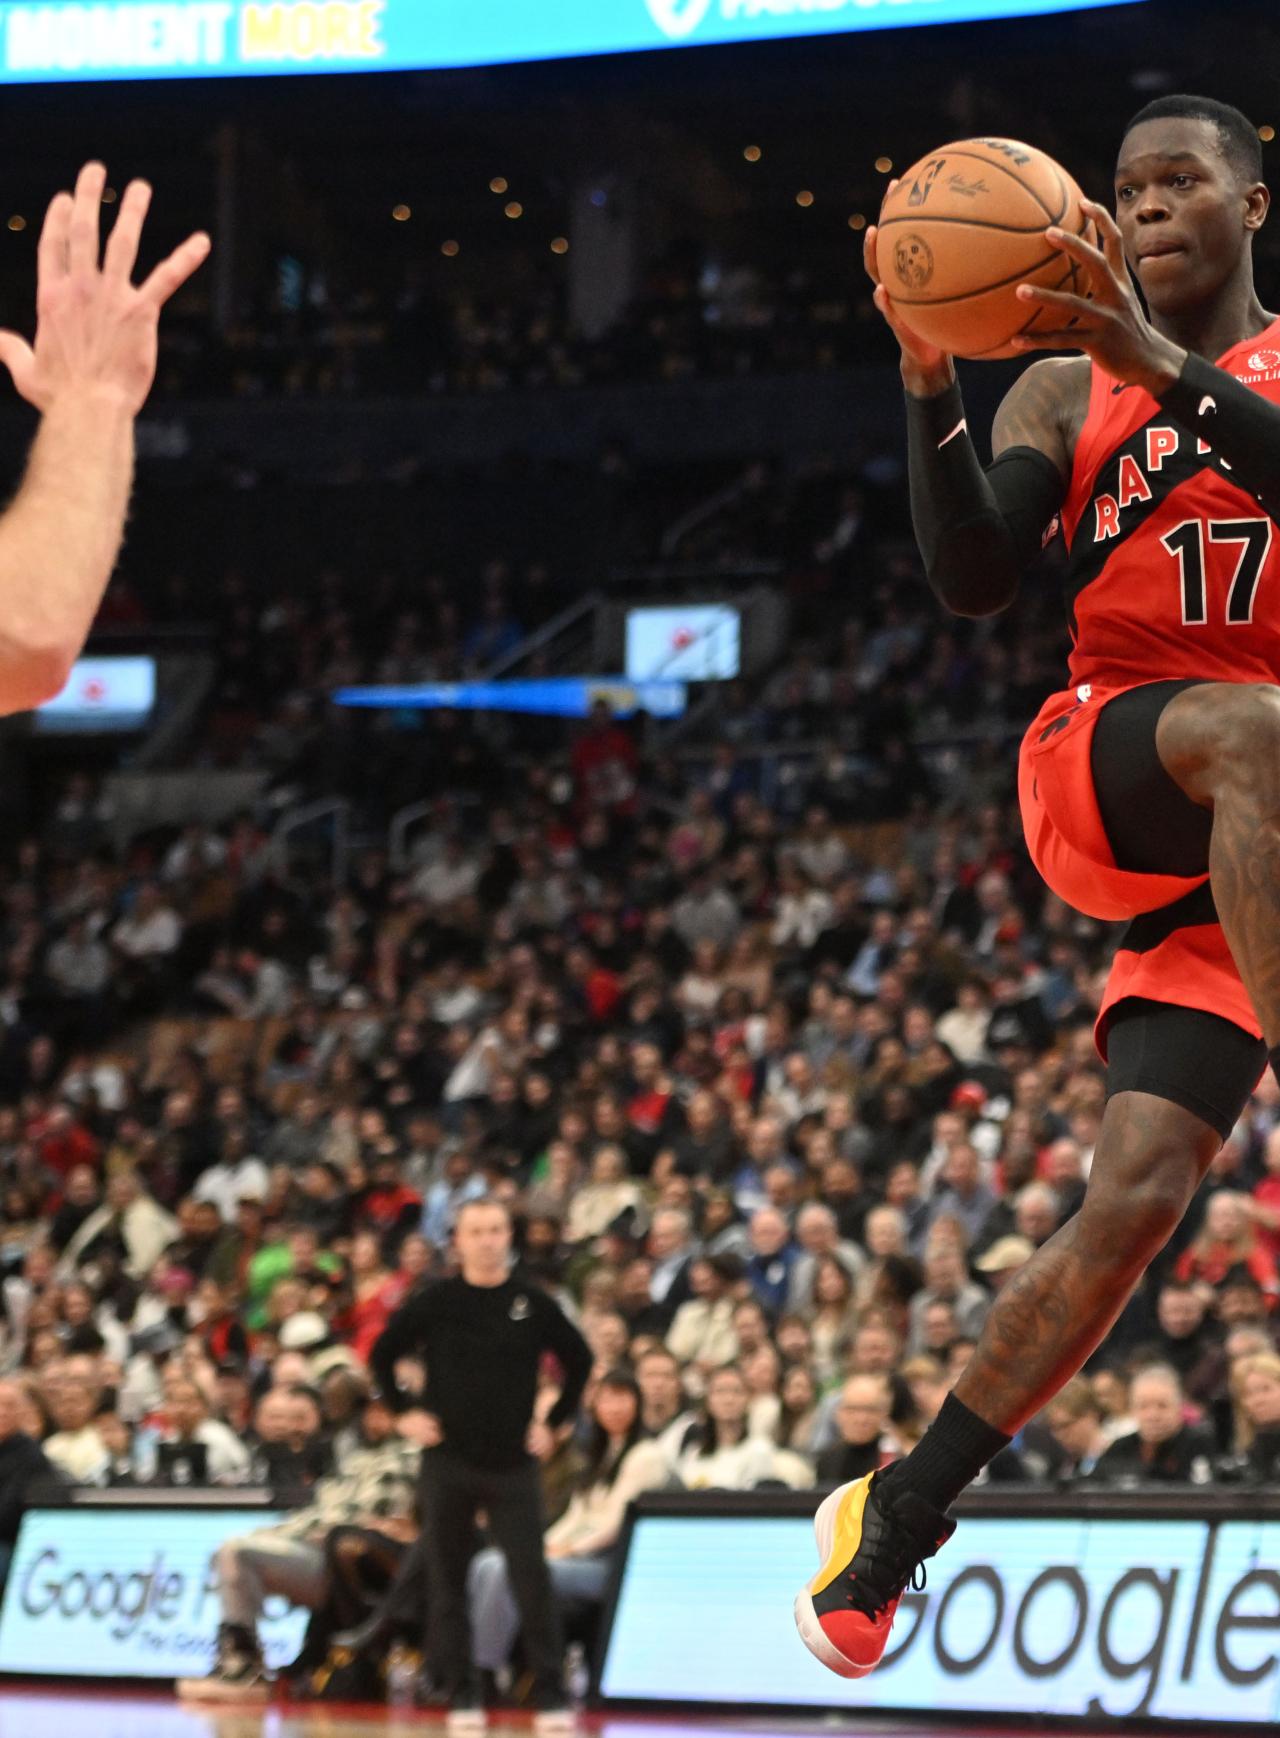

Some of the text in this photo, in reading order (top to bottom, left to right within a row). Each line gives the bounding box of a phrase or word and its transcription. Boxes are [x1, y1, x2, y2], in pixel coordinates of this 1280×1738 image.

[6, 1, 388, 70] MOMENT MORE
[1159, 516, 1272, 626] 17
[21, 1546, 184, 1641] Google
